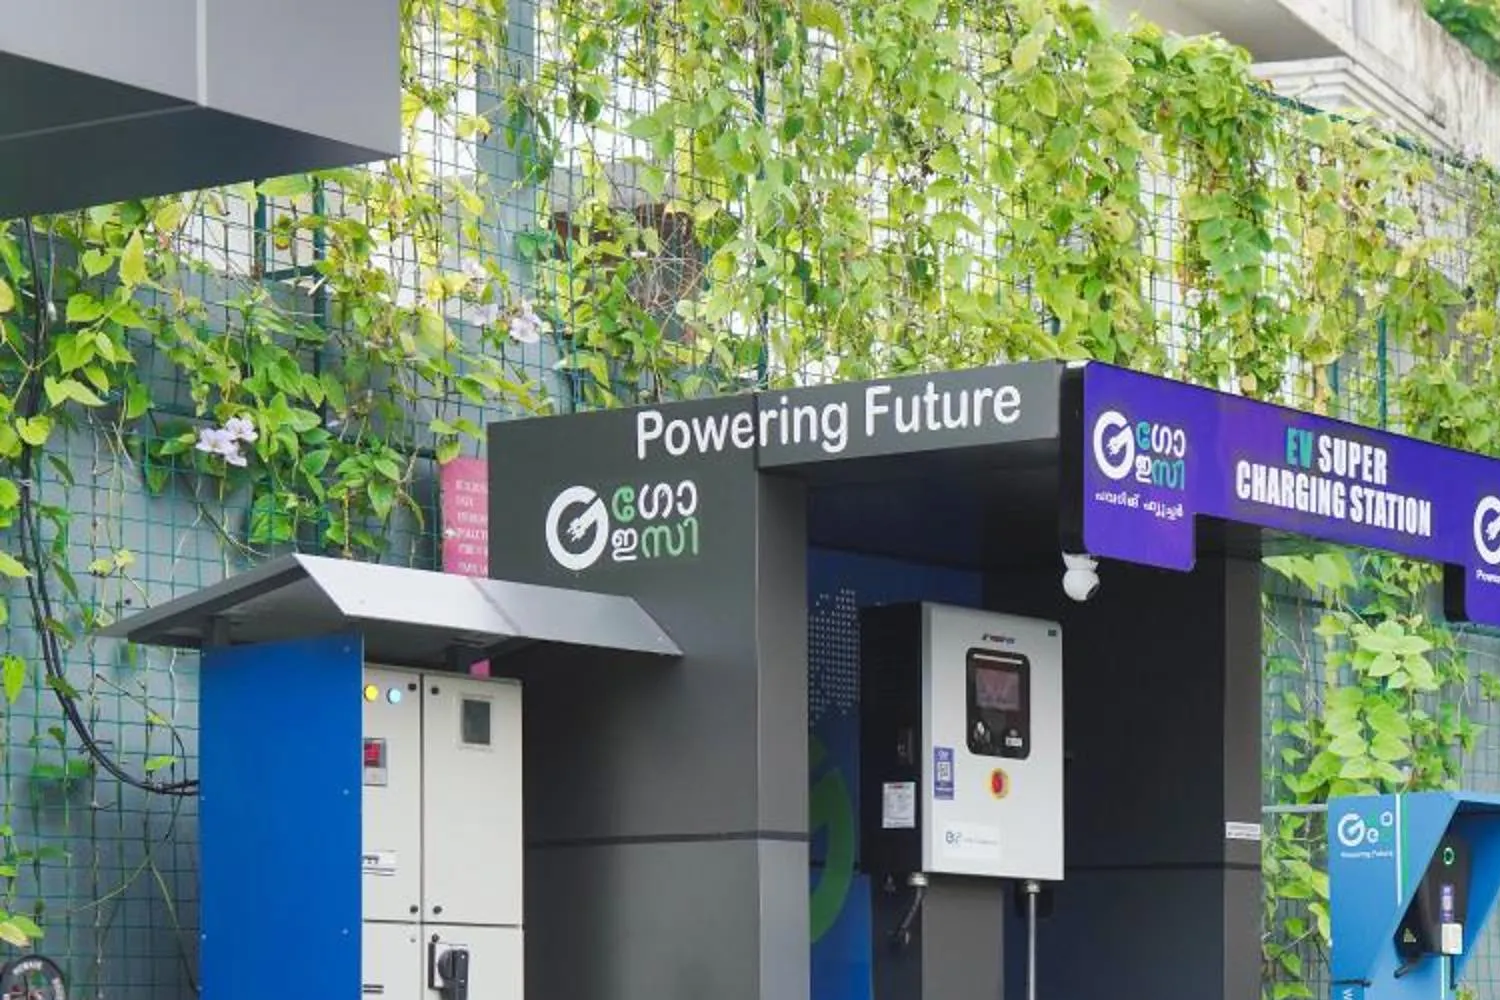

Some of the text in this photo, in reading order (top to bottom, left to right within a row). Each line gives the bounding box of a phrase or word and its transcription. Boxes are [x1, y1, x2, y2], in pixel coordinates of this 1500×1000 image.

[636, 381, 1021, 459] Powering Future
[1286, 427, 1387, 485] EV SUPER
[611, 479, 698, 522] ഗോ
[1235, 460, 1431, 537] CHARGING STATION
[611, 517, 699, 562] ഇസി
